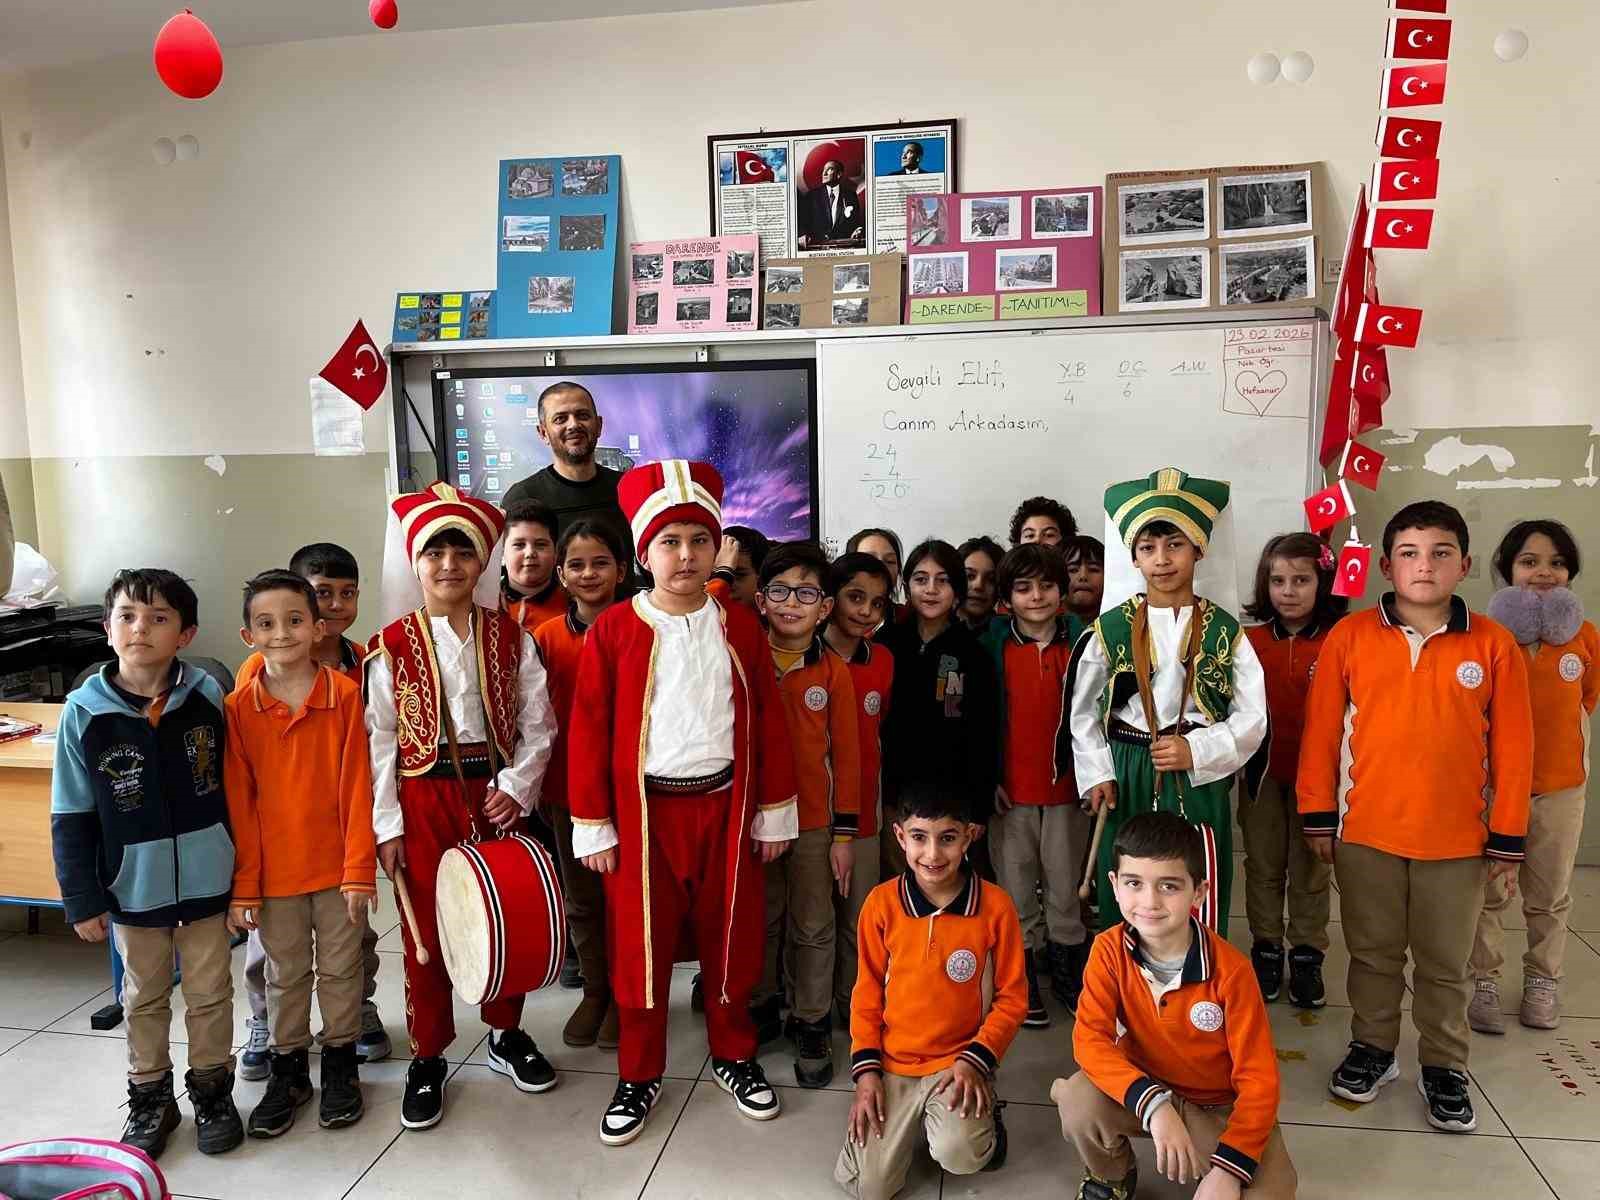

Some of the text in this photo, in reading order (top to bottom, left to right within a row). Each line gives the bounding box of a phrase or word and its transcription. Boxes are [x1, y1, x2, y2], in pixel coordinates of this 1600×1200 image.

[665, 241, 721, 255] DARENDE
[921, 302, 984, 317] DARENDE
[887, 363, 942, 400] Sevgili
[1064, 382, 1133, 405] 4 6
[882, 410, 937, 431] Canım
